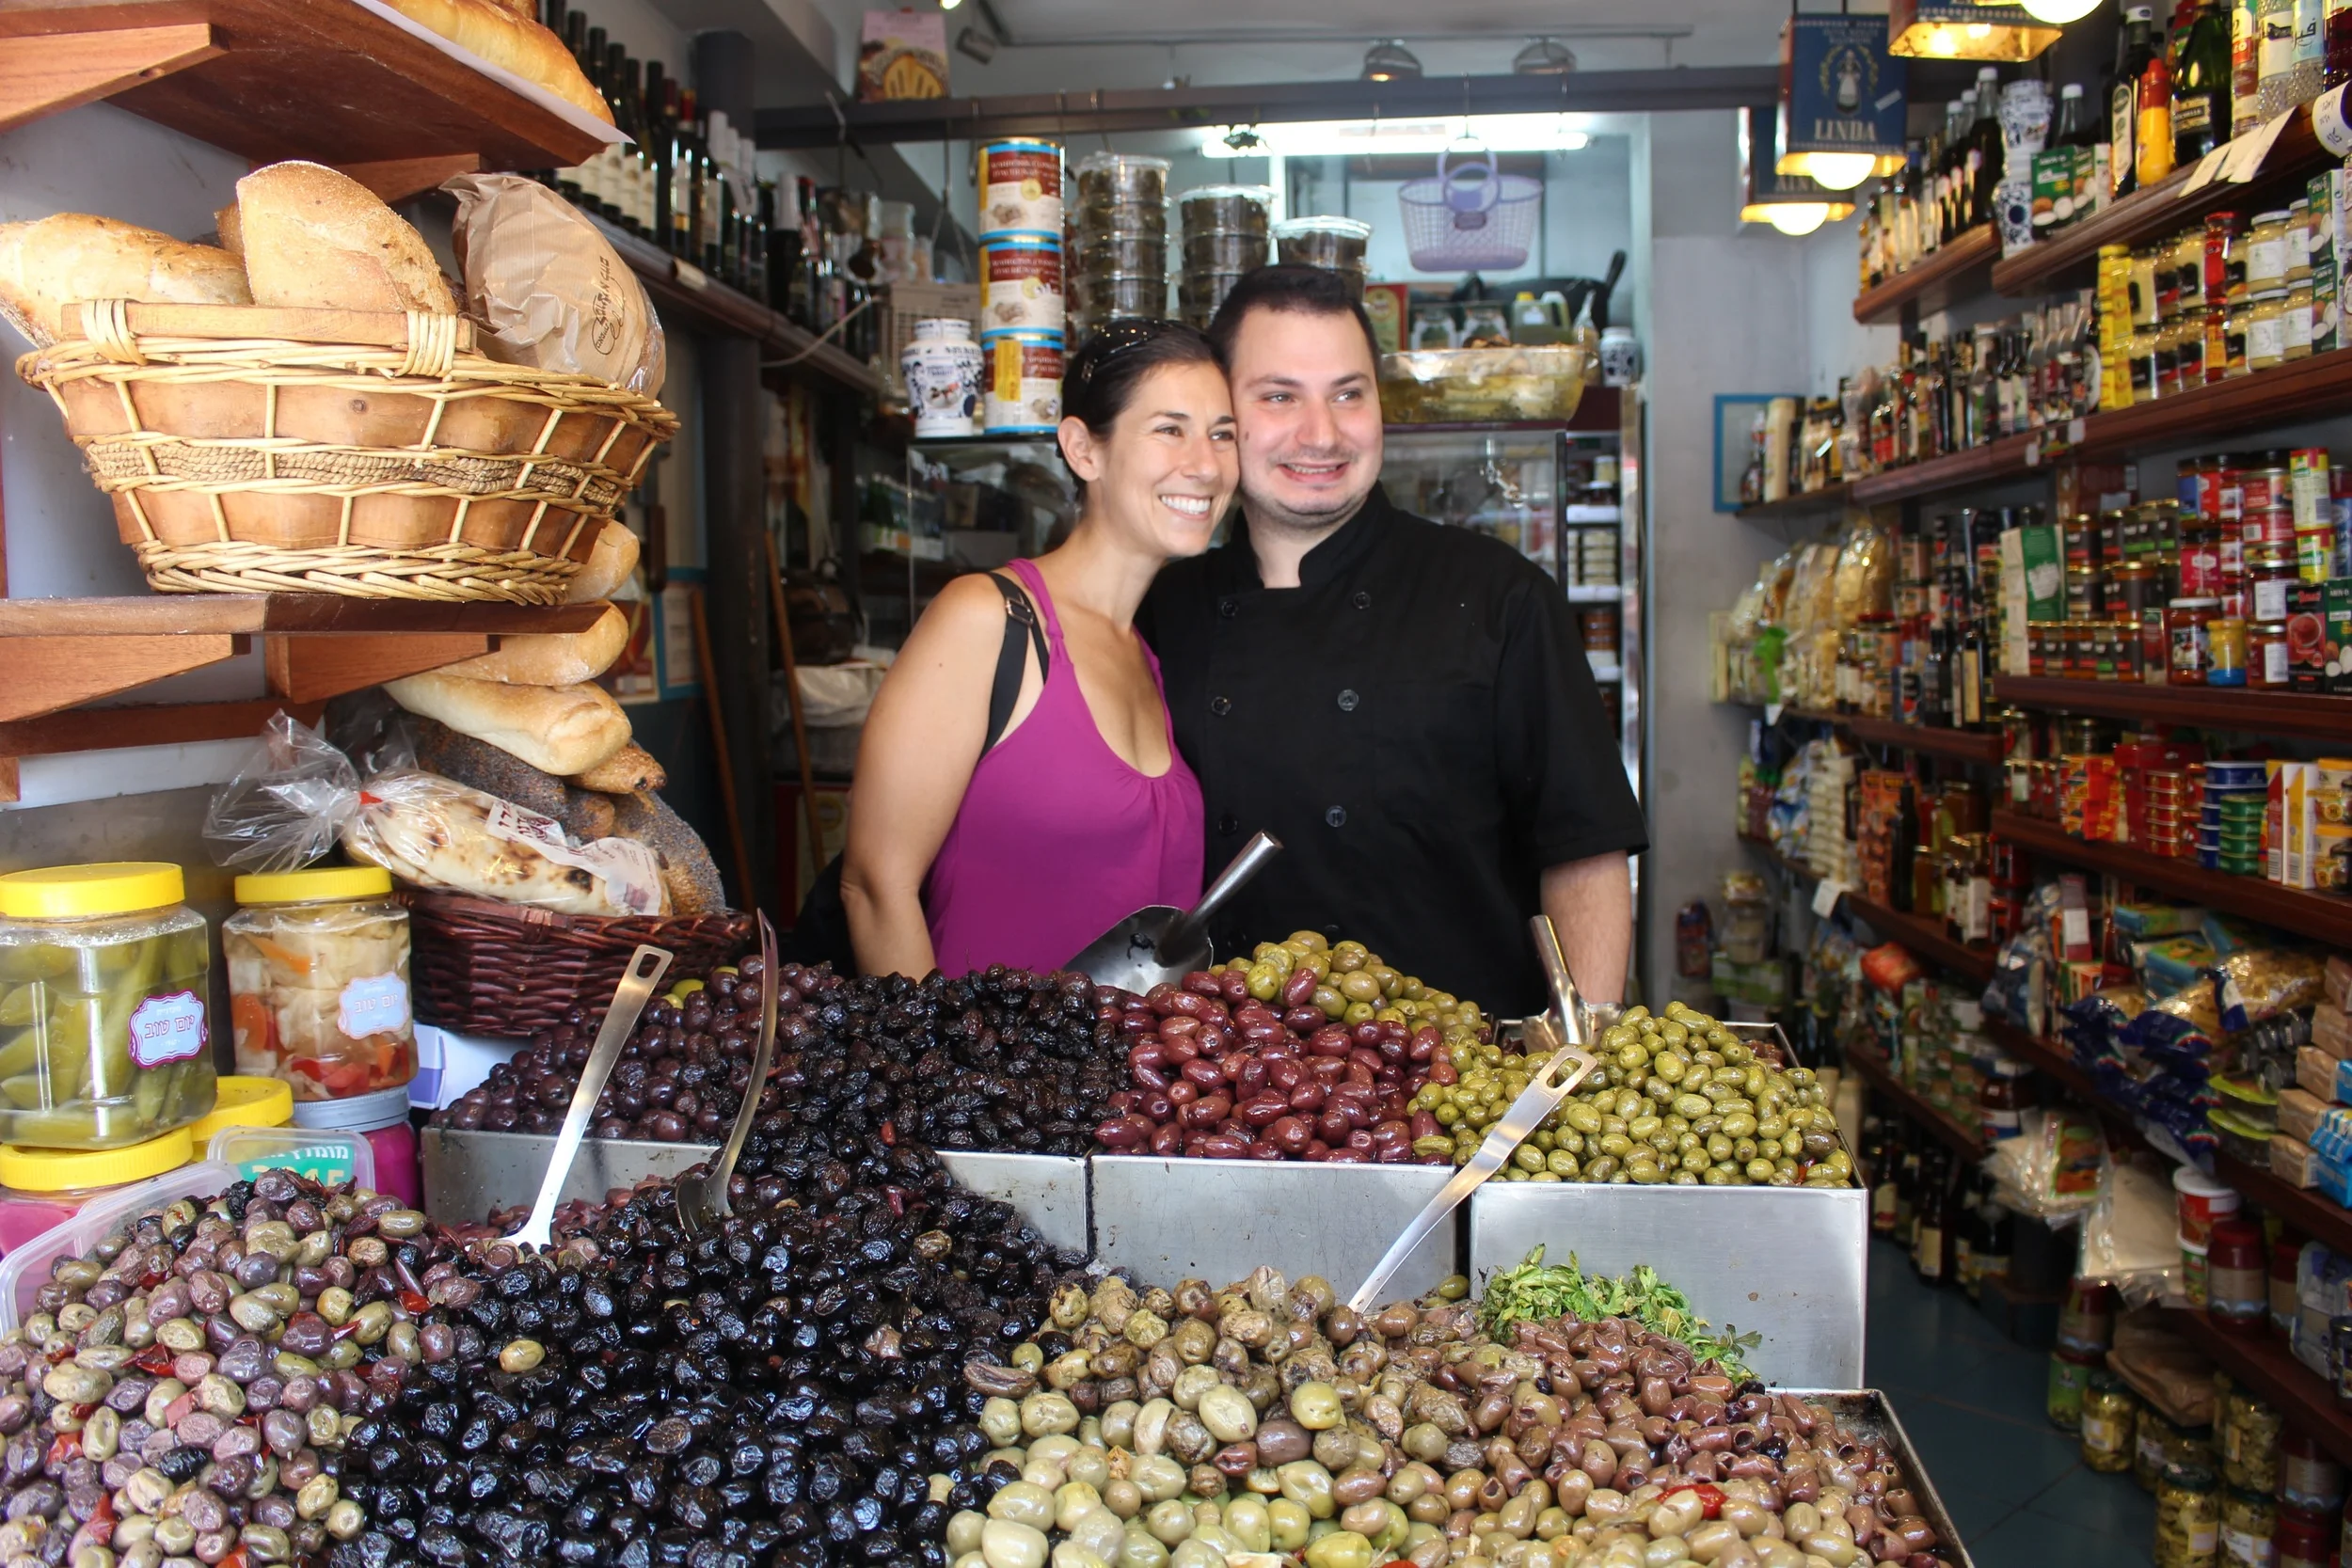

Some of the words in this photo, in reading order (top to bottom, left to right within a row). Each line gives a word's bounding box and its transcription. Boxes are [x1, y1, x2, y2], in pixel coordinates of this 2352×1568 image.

[1814, 119, 1876, 142] LINDA
[354, 998, 376, 1013] טוב
[381, 993, 398, 1008] יום
[144, 1020, 169, 1038] טוב
[175, 1015, 195, 1033] יום
